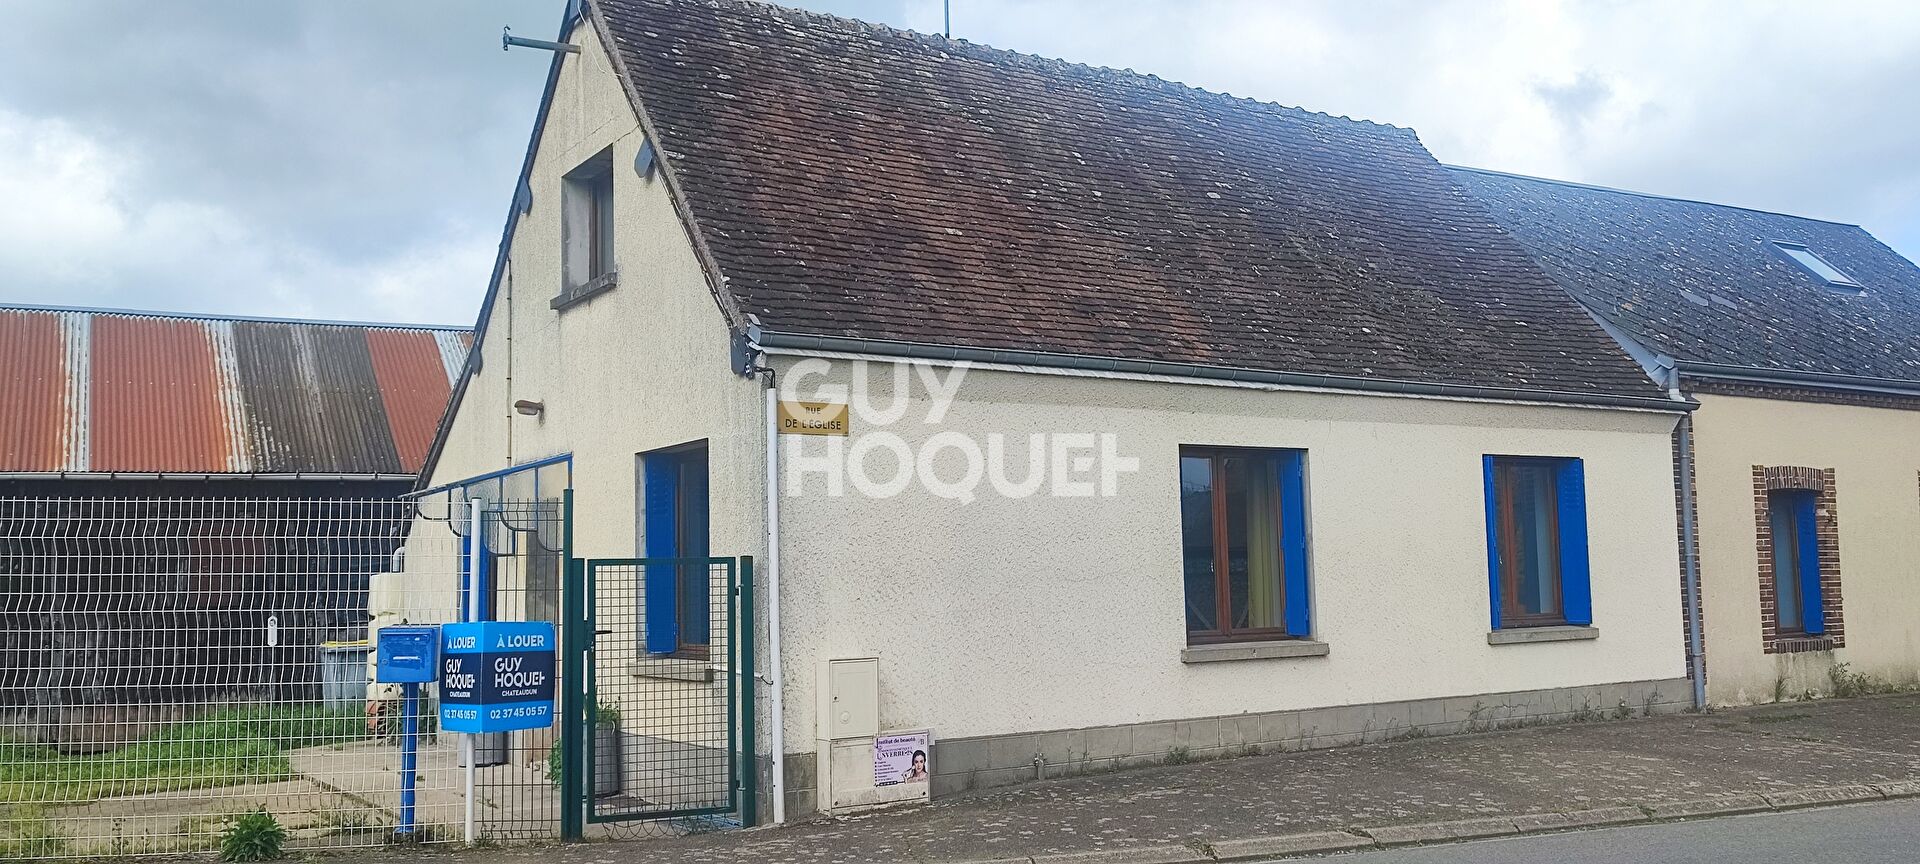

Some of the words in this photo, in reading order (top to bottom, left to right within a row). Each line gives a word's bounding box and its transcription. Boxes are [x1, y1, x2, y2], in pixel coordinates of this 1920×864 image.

[805, 407, 821, 415] RUE
[785, 418, 798, 428] DE
[453, 636, 476, 649] LOUER
[496, 634, 505, 648] À
[508, 635, 544, 648] LOUER
[445, 659, 462, 673] GUY
[494, 657, 522, 672] GUY
[445, 674, 476, 689] HOQUET
[494, 671, 545, 688] HOQUET
[501, 688, 537, 697] CHATEAUDUN
[444, 709, 451, 718] 02
[451, 710, 457, 718] 37
[457, 710, 463, 718] 45
[464, 711, 470, 719] 05
[470, 710, 477, 719] 57
[490, 709, 501, 719] 02
[502, 708, 513, 718] 37
[513, 707, 524, 717] 45
[525, 706, 536, 716] 05
[537, 706, 547, 715] 57
